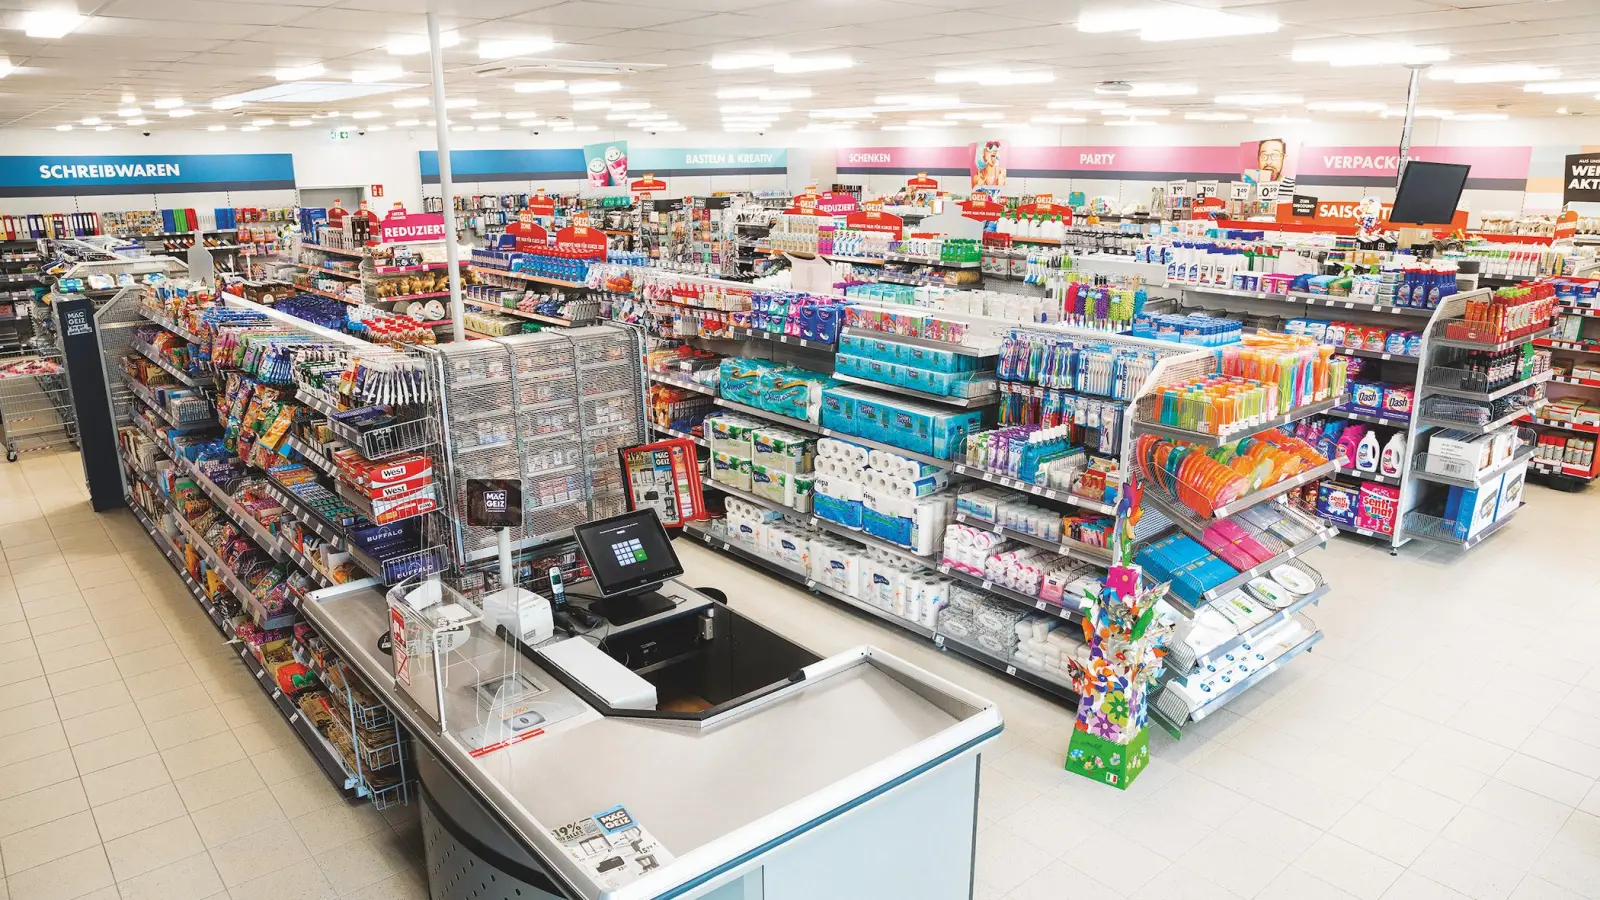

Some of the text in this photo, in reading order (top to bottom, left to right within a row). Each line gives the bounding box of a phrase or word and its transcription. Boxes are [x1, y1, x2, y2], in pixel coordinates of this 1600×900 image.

[686, 154, 772, 164] BASTELN & KREATIV
[848, 154, 890, 162] SCHENKEN
[1080, 154, 1116, 164] PARTY
[40, 164, 180, 179] SCHREIBWAREN
[819, 203, 855, 212] REDUZIERT
[866, 203, 882, 211] GEIZ
[520, 213, 531, 222] GEIZ
[574, 217, 588, 226] GEIZ
[384, 224, 445, 237] REDUZIERT
[1359, 390, 1376, 401] Dash
[1389, 398, 1408, 407] Dash
[384, 467, 404, 476] West
[385, 486, 405, 495] West
[1364, 496, 1388, 510] senti
[1372, 505, 1392, 517] mat
[367, 529, 403, 542] BUFFALO
[600, 810, 626, 824] MÄC
[604, 818, 631, 829] GEIZ
[567, 830, 584, 840] ALLES
